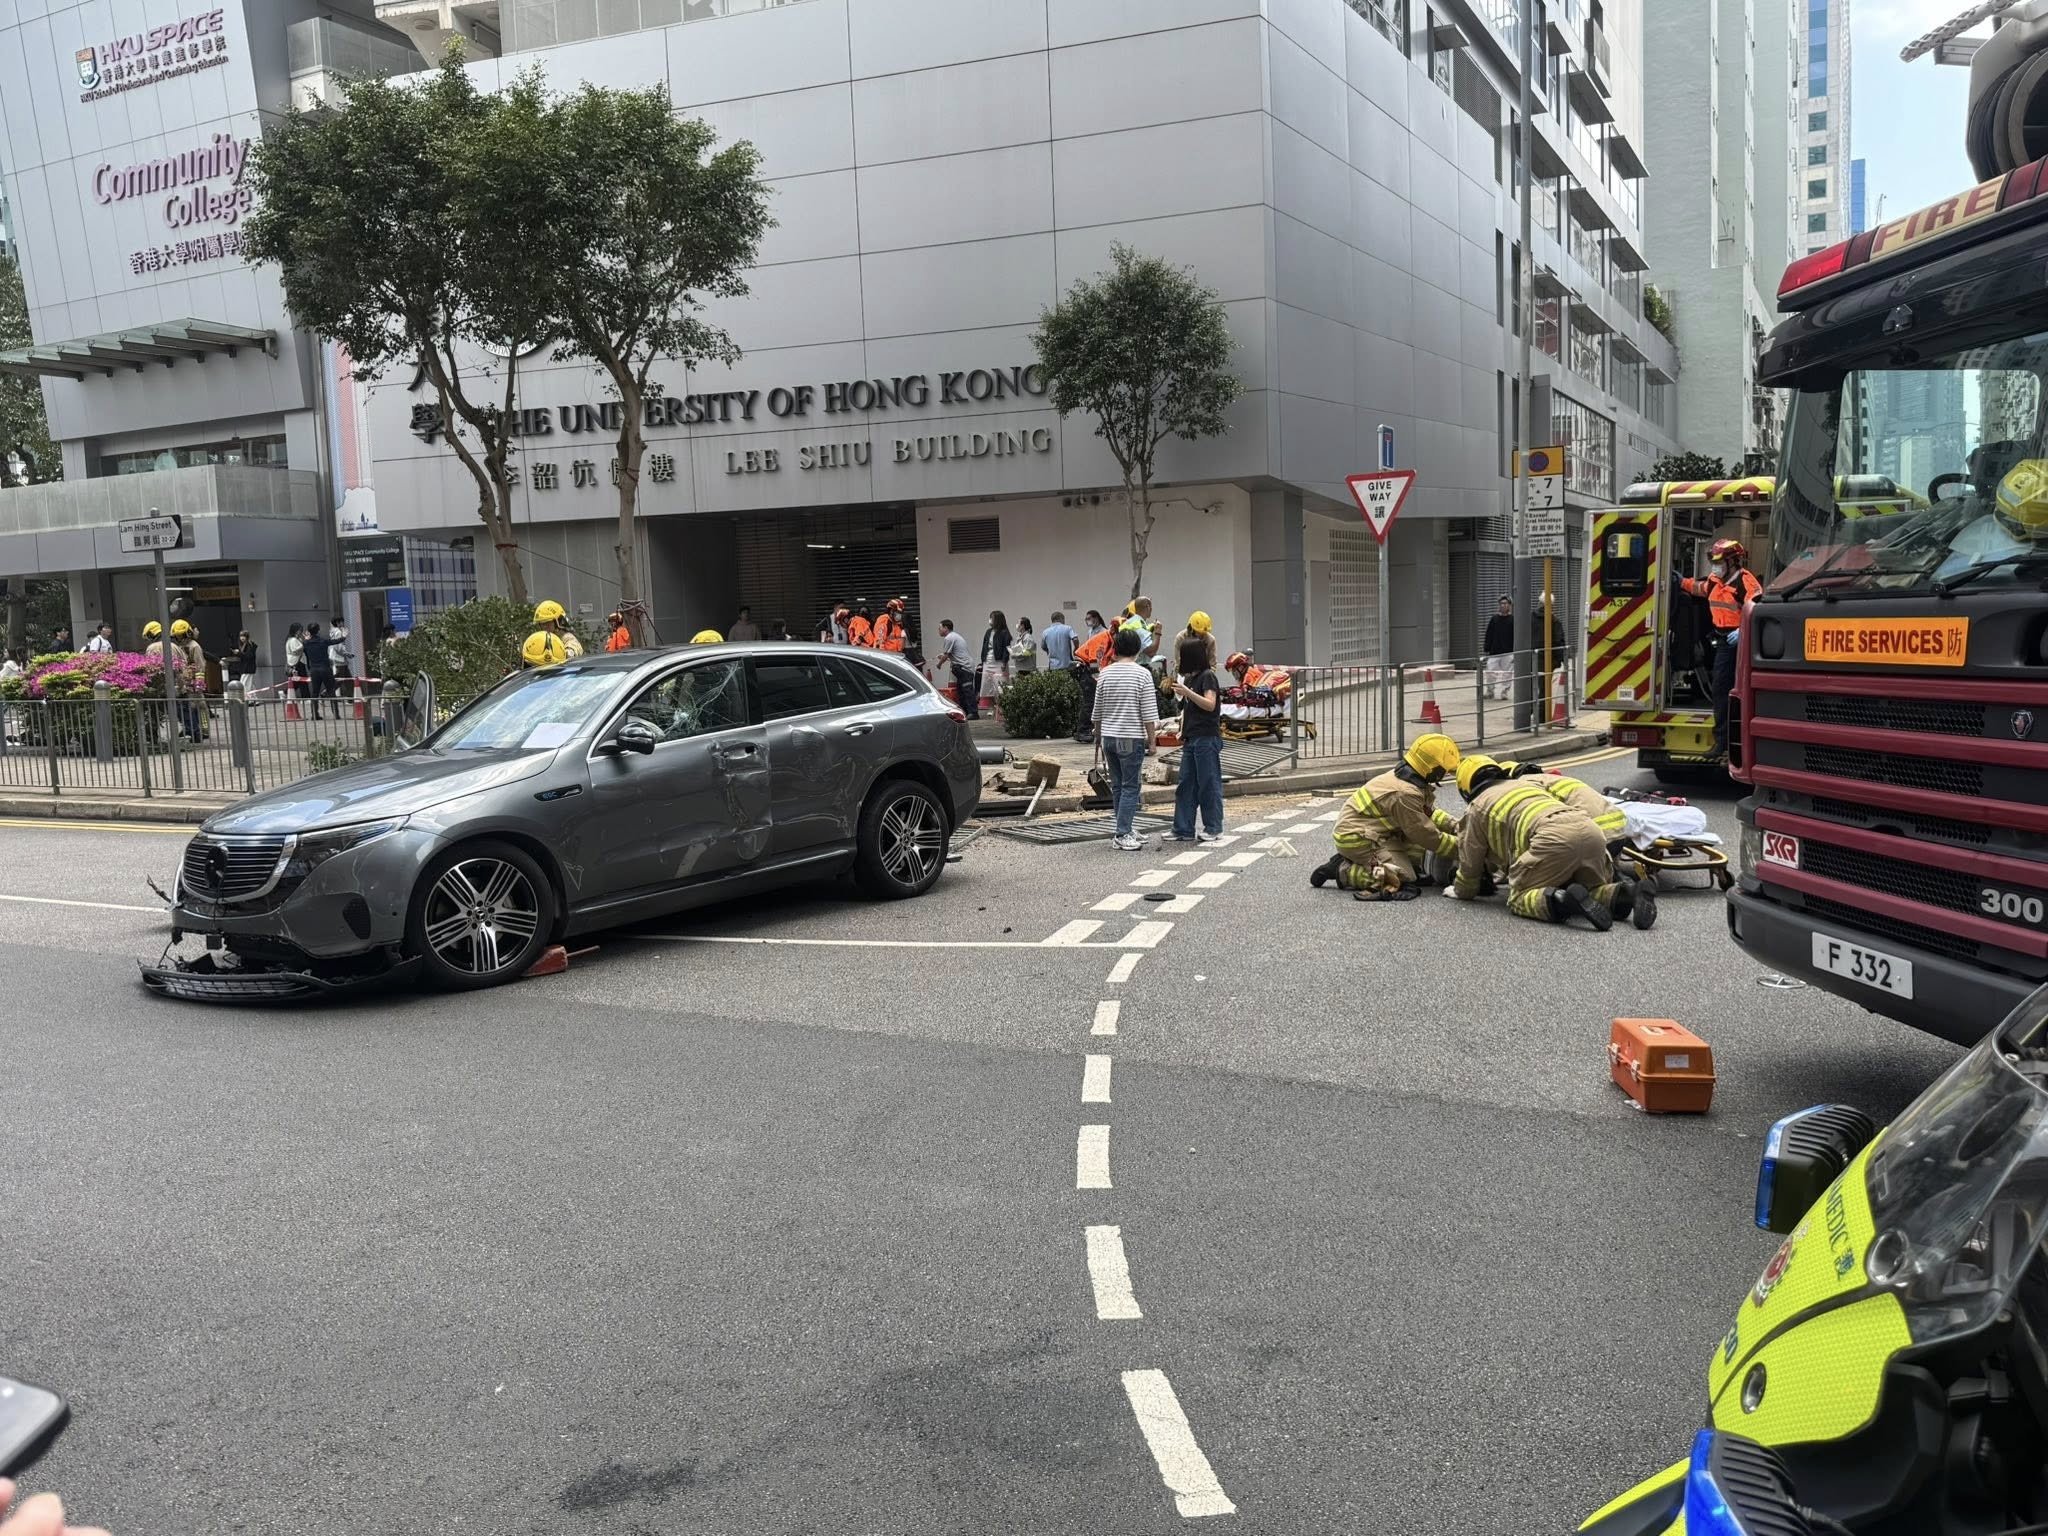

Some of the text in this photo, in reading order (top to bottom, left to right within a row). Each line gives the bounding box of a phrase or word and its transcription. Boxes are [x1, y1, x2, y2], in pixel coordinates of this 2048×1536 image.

[99, 8, 224, 66] HKU SPACE
[92, 133, 250, 205] Community
[164, 185, 252, 229] College
[1872, 177, 2004, 253] FIRE
[556, 390, 760, 433] UNIERSITY
[767, 385, 813, 417] OF
[822, 374, 929, 413] HONG
[938, 363, 1048, 403] KONG
[724, 427, 1052, 475] LEE SHIU BUILDING
[1368, 480, 1392, 491] GIVE
[1369, 492, 1391, 502] WAY
[1543, 477, 1553, 489] 7
[1543, 495, 1553, 507] 7
[134, 523, 149, 533] Hing
[151, 521, 172, 530] Street
[1807, 628, 1818, 654] 消
[1822, 629, 1943, 654] FIRE SERVICES
[1947, 627, 1962, 657] 防
[1980, 888, 2044, 923] 300
[1828, 941, 1893, 988] F 332
